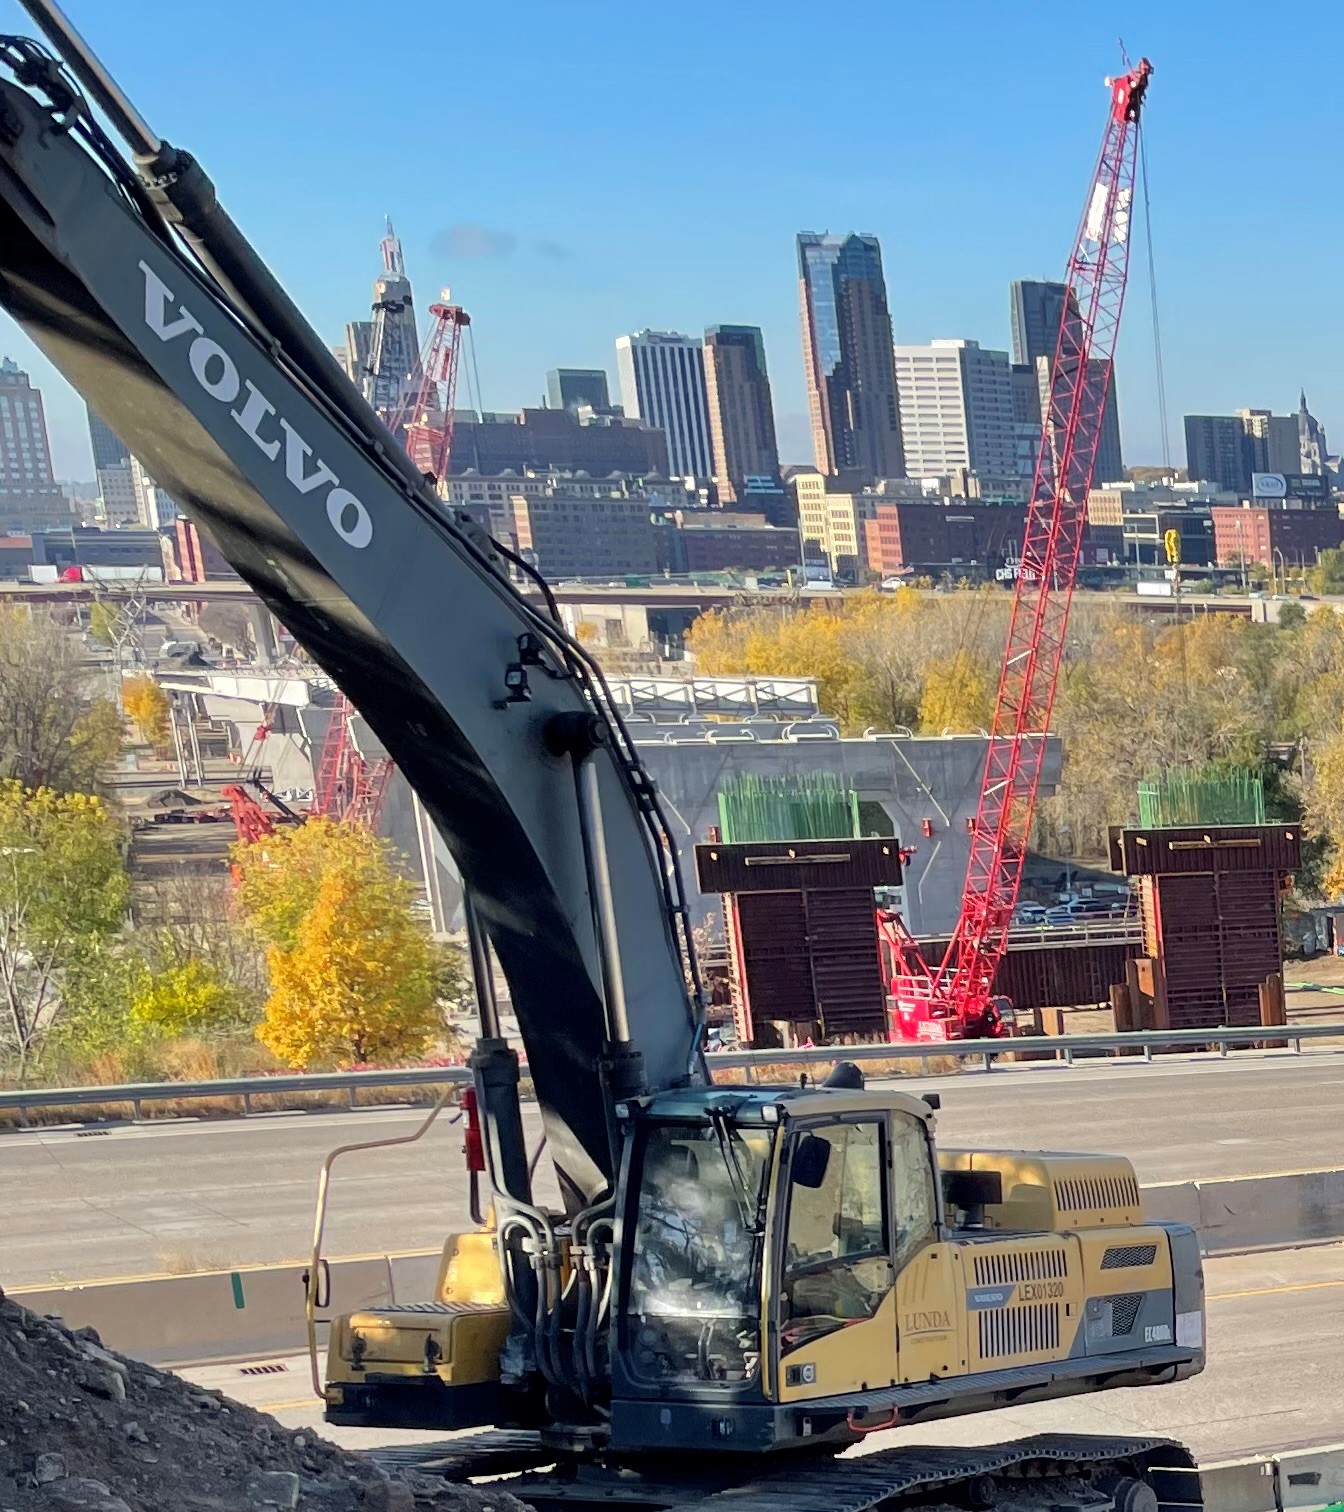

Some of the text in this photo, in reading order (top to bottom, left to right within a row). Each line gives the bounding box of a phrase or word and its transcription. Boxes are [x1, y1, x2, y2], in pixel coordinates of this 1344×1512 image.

[139, 260, 373, 548] VOLVO
[995, 569, 1013, 580] CHS
[974, 1293, 1004, 1303] VOLVO
[1018, 1282, 1065, 1301] LEX01320
[905, 1310, 950, 1332] LUNDA
